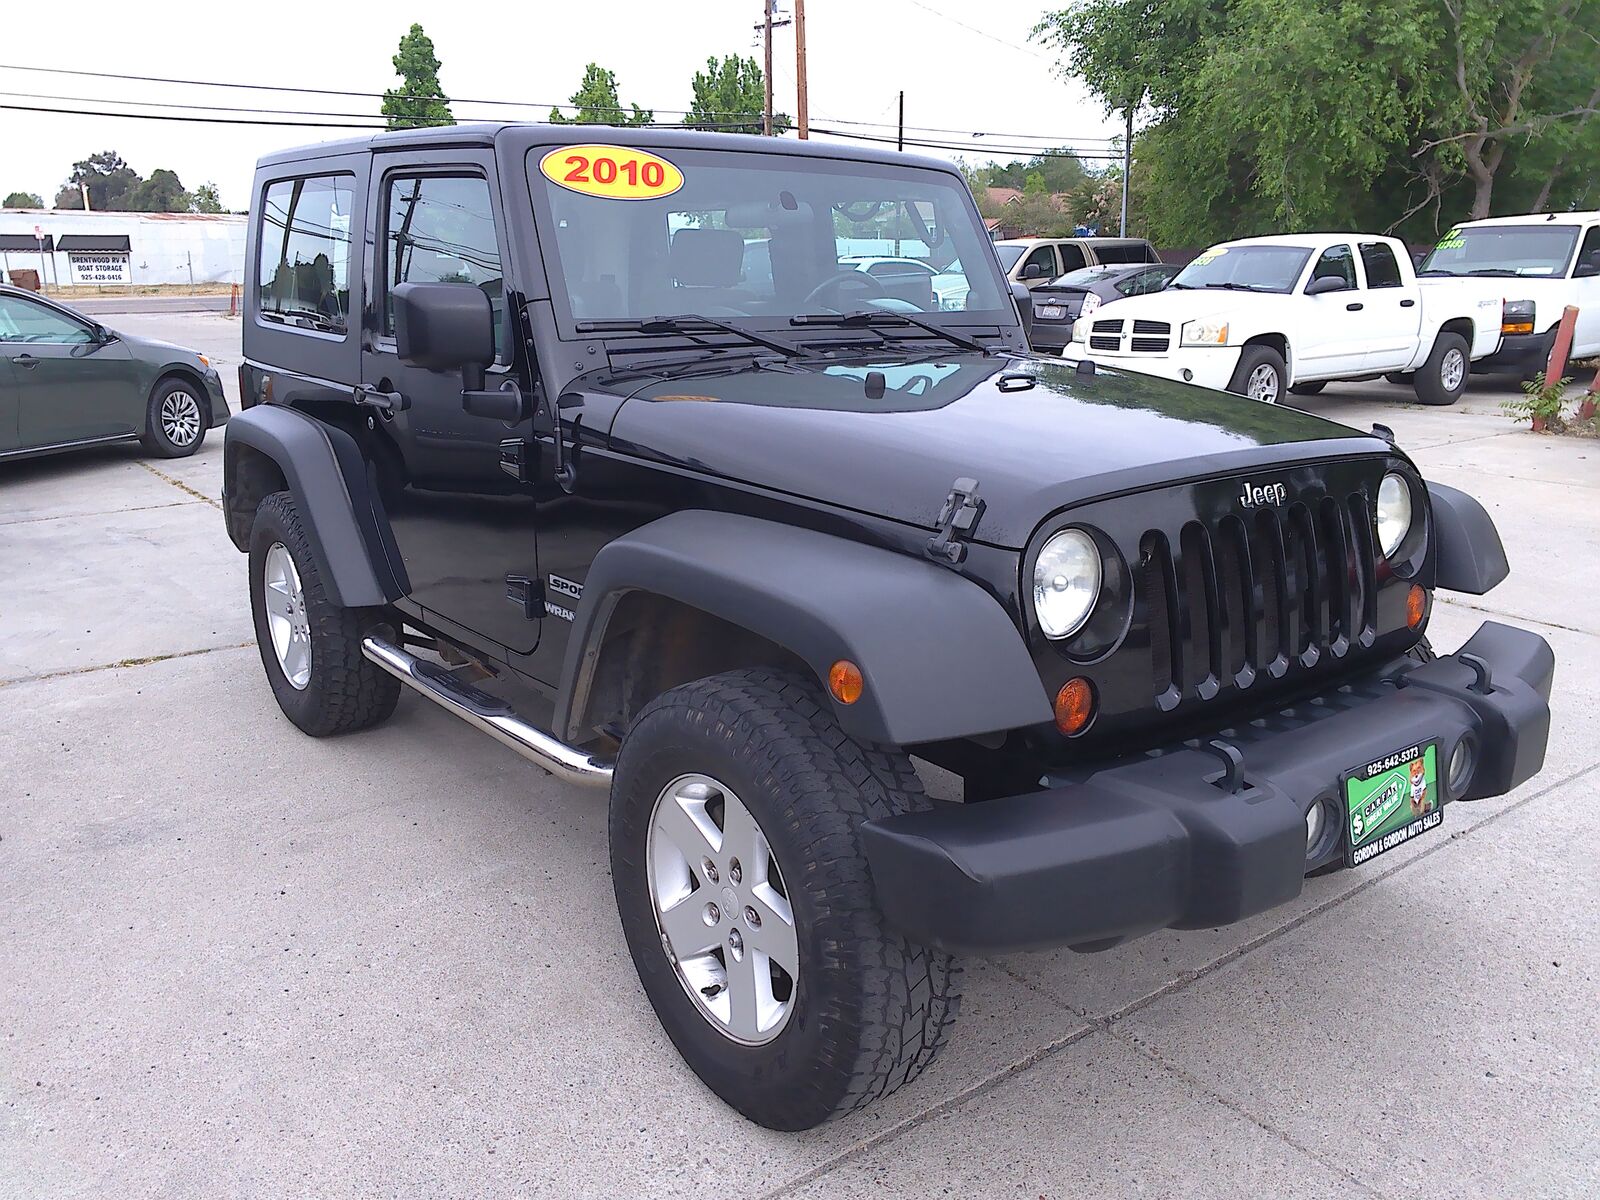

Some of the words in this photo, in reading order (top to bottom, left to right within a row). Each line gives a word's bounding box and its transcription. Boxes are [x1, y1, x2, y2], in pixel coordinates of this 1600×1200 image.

[564, 156, 664, 187] 2010
[1237, 482, 1286, 508] Jeep
[1367, 746, 1419, 776] 925-642-5373
[1364, 781, 1397, 817] CARFAX
[1354, 841, 1379, 864] GORDON
[1379, 838, 1384, 851] &
[1384, 827, 1408, 849] GORDON
[1408, 820, 1423, 838] AUTO
[1424, 811, 1441, 829] SALES
